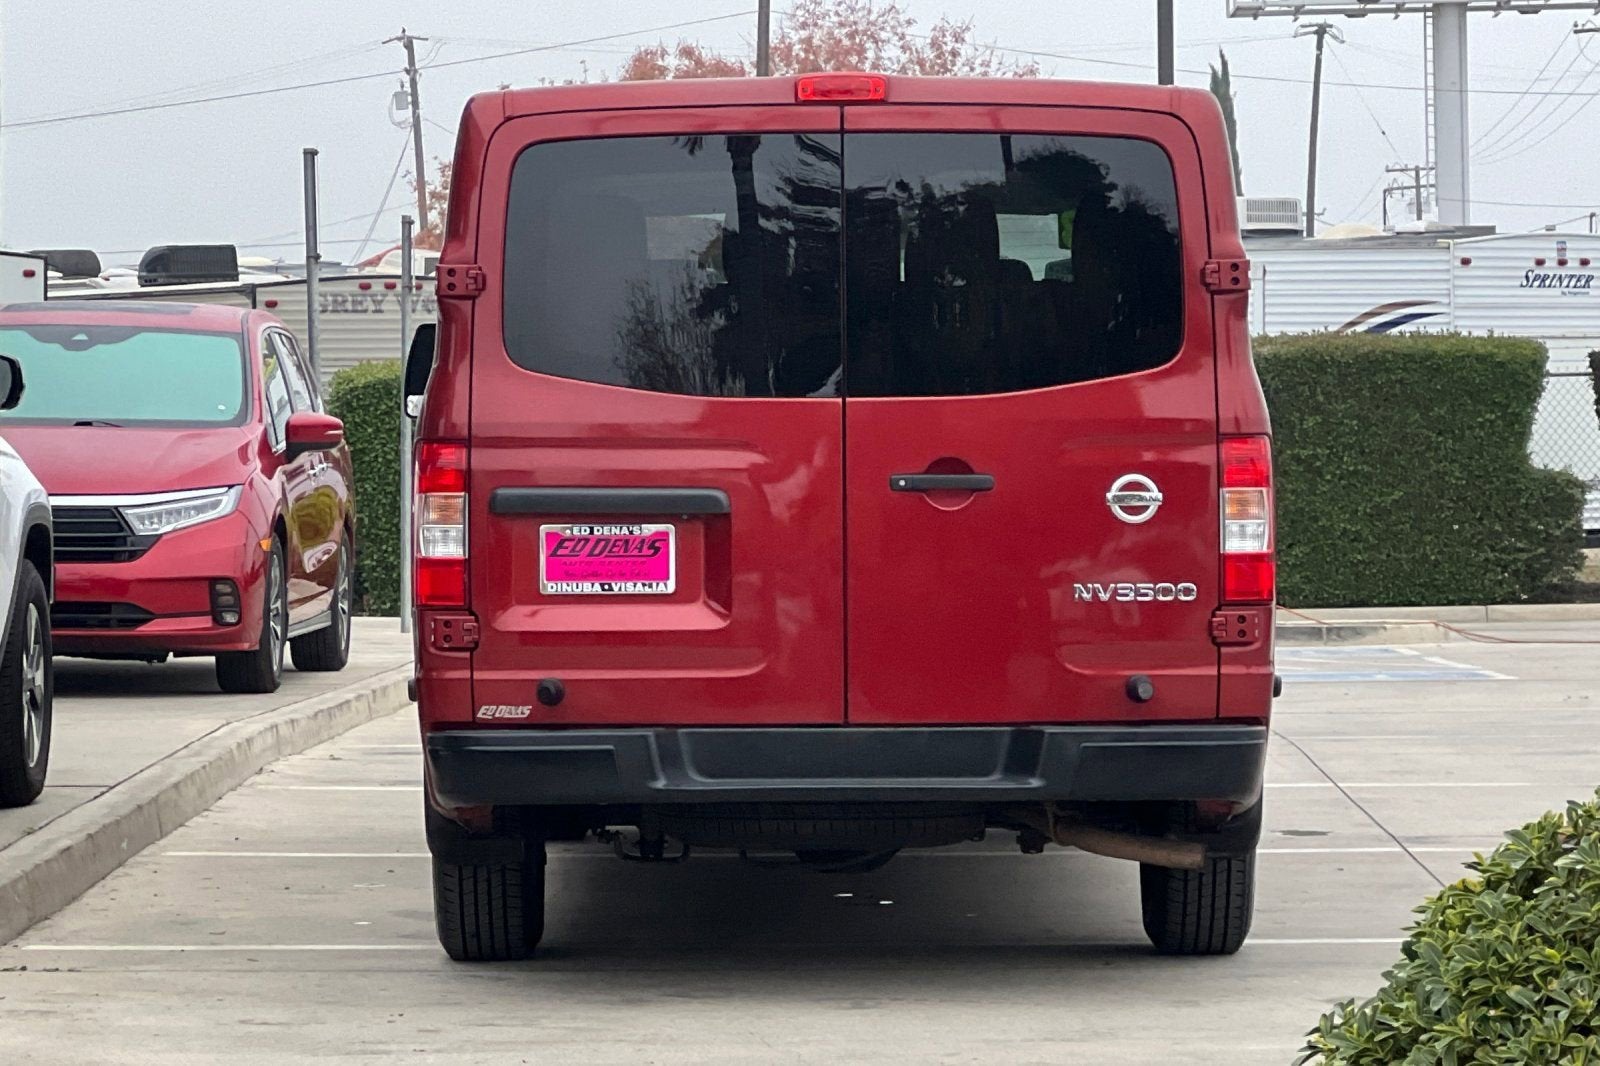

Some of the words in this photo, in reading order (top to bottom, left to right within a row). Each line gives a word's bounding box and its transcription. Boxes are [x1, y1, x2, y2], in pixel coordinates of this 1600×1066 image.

[1519, 268, 1595, 289] SPRINTER
[572, 526, 591, 535] ED
[593, 526, 641, 535] DENA'S
[548, 538, 591, 557] ED
[547, 582, 602, 592] DINUBA
[611, 582, 668, 592] VISALIA
[1073, 583, 1197, 601] NV3500
[476, 705, 498, 719] ED
